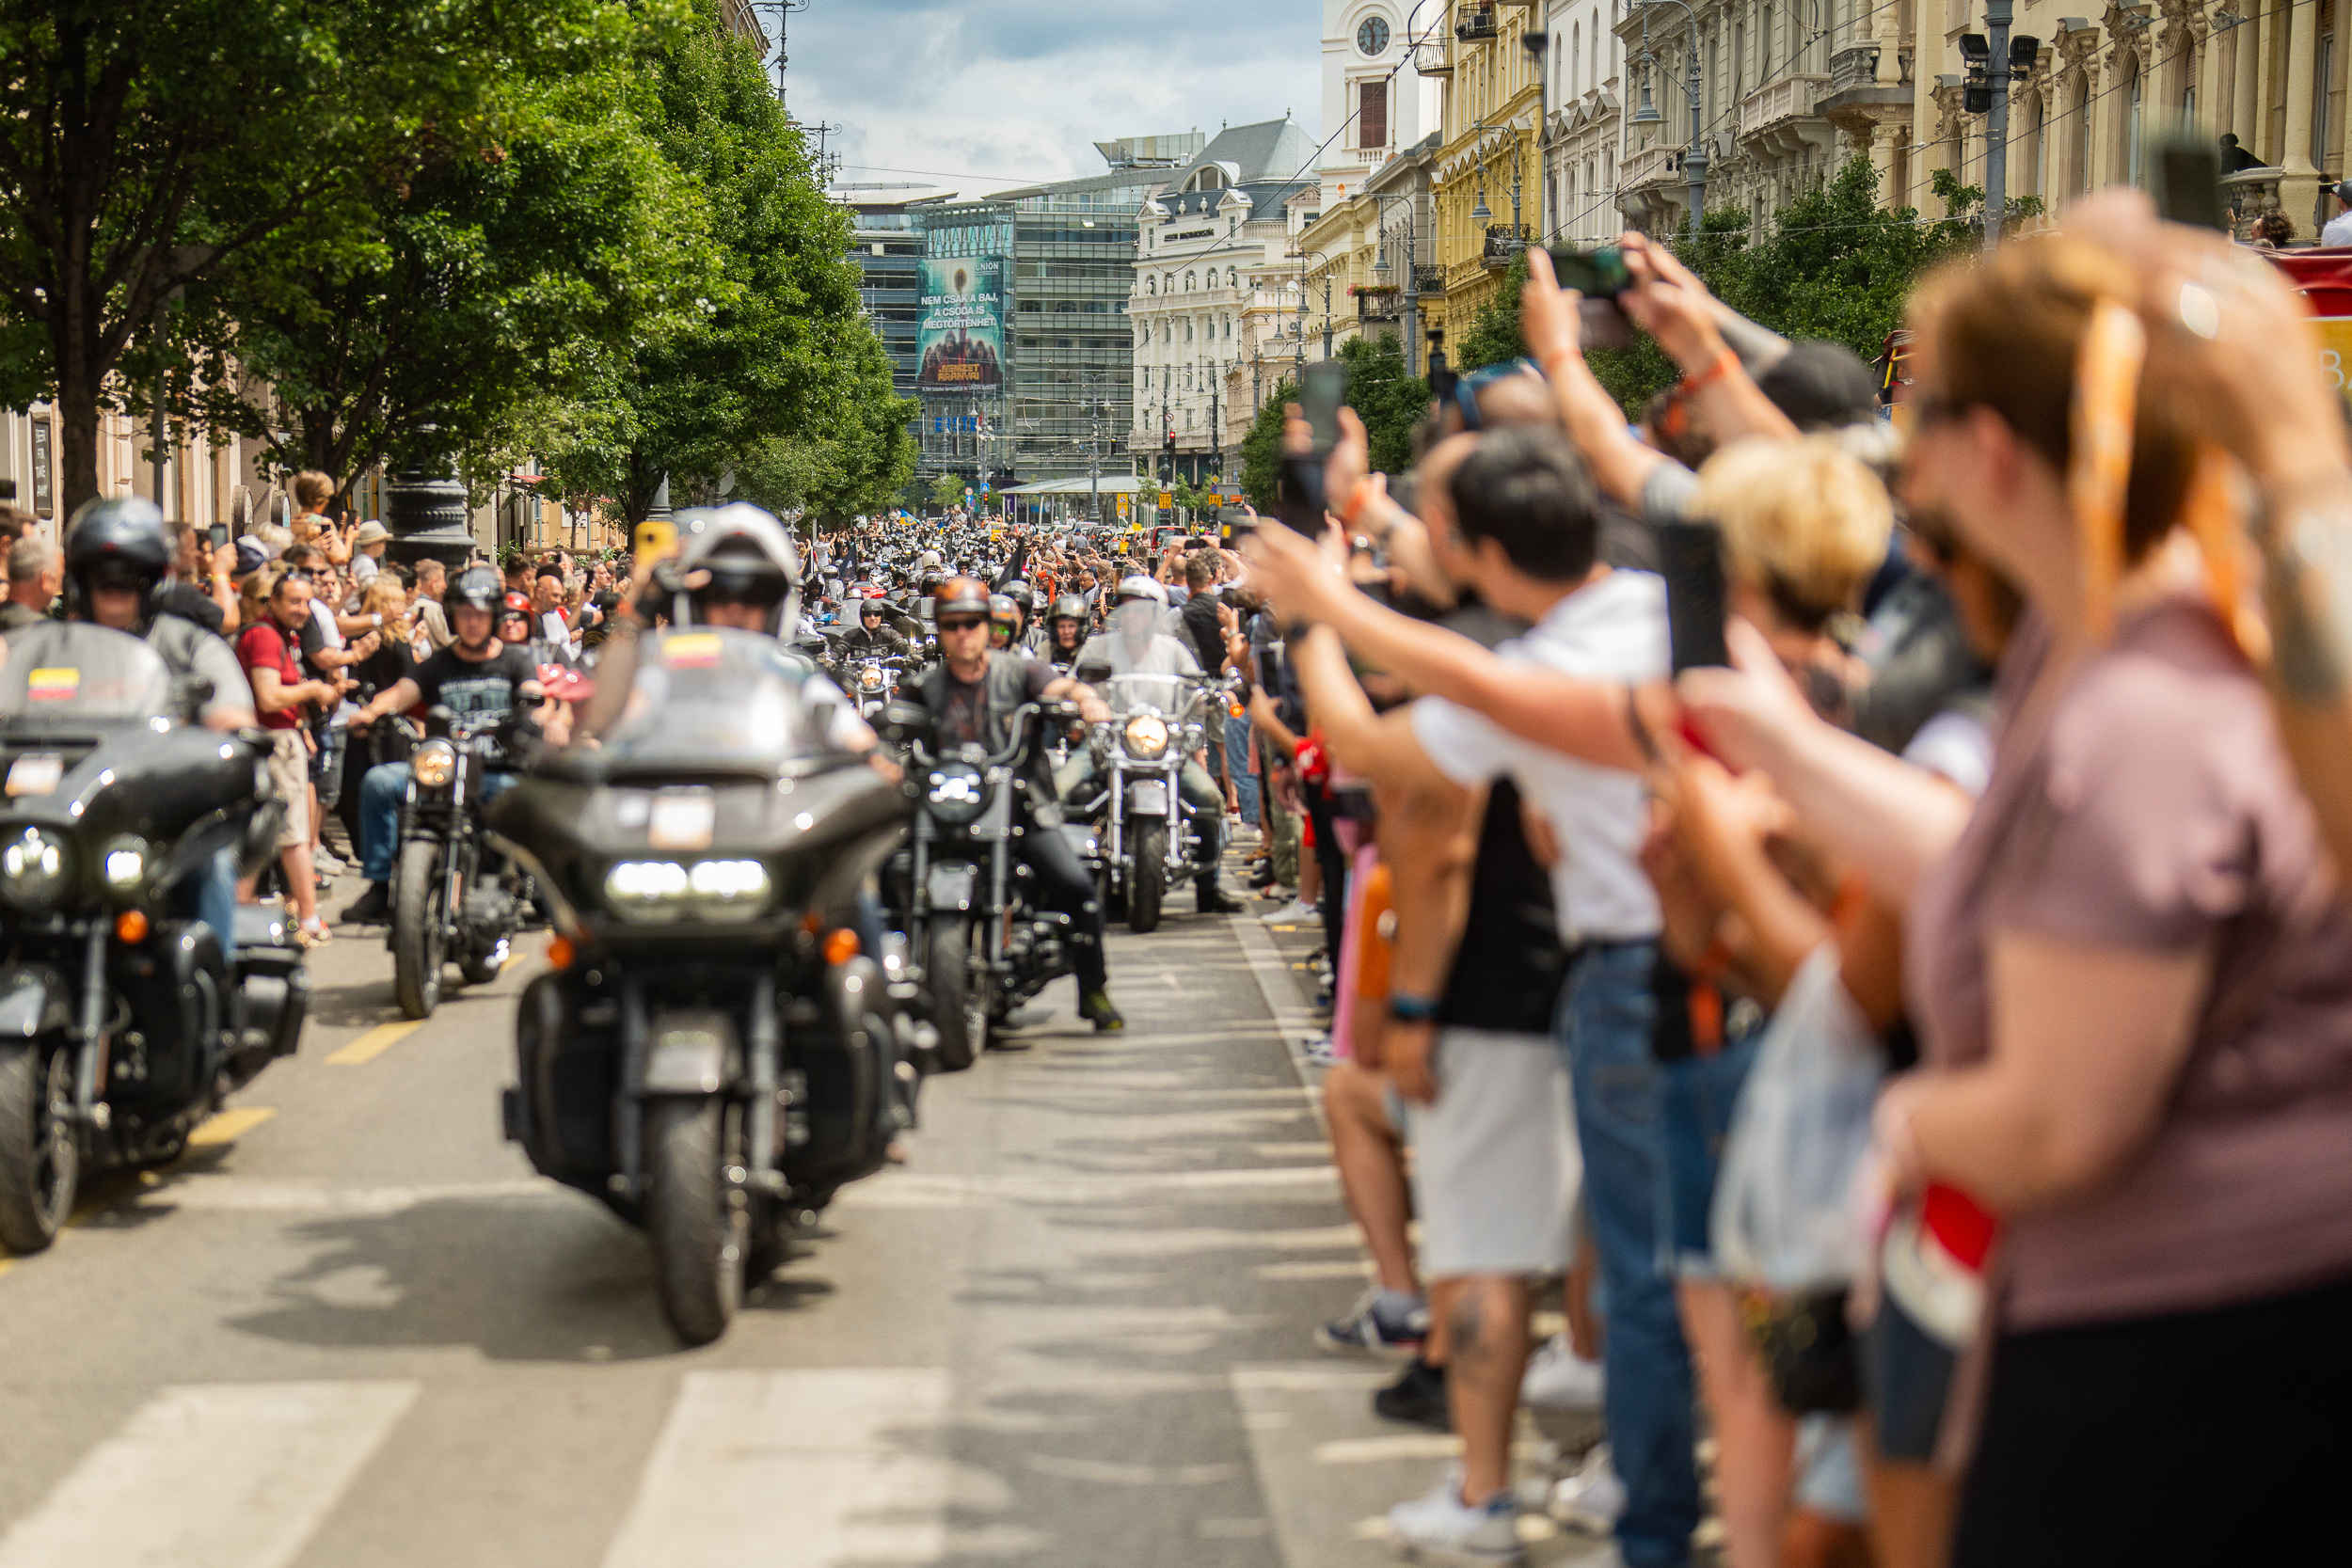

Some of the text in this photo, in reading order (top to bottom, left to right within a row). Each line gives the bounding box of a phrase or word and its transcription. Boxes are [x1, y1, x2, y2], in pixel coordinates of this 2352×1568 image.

[975, 261, 999, 272] UNION
[944, 294, 966, 304] CSAK
[978, 293, 998, 302] BAJ,
[934, 306, 984, 316] A CSODA IS
